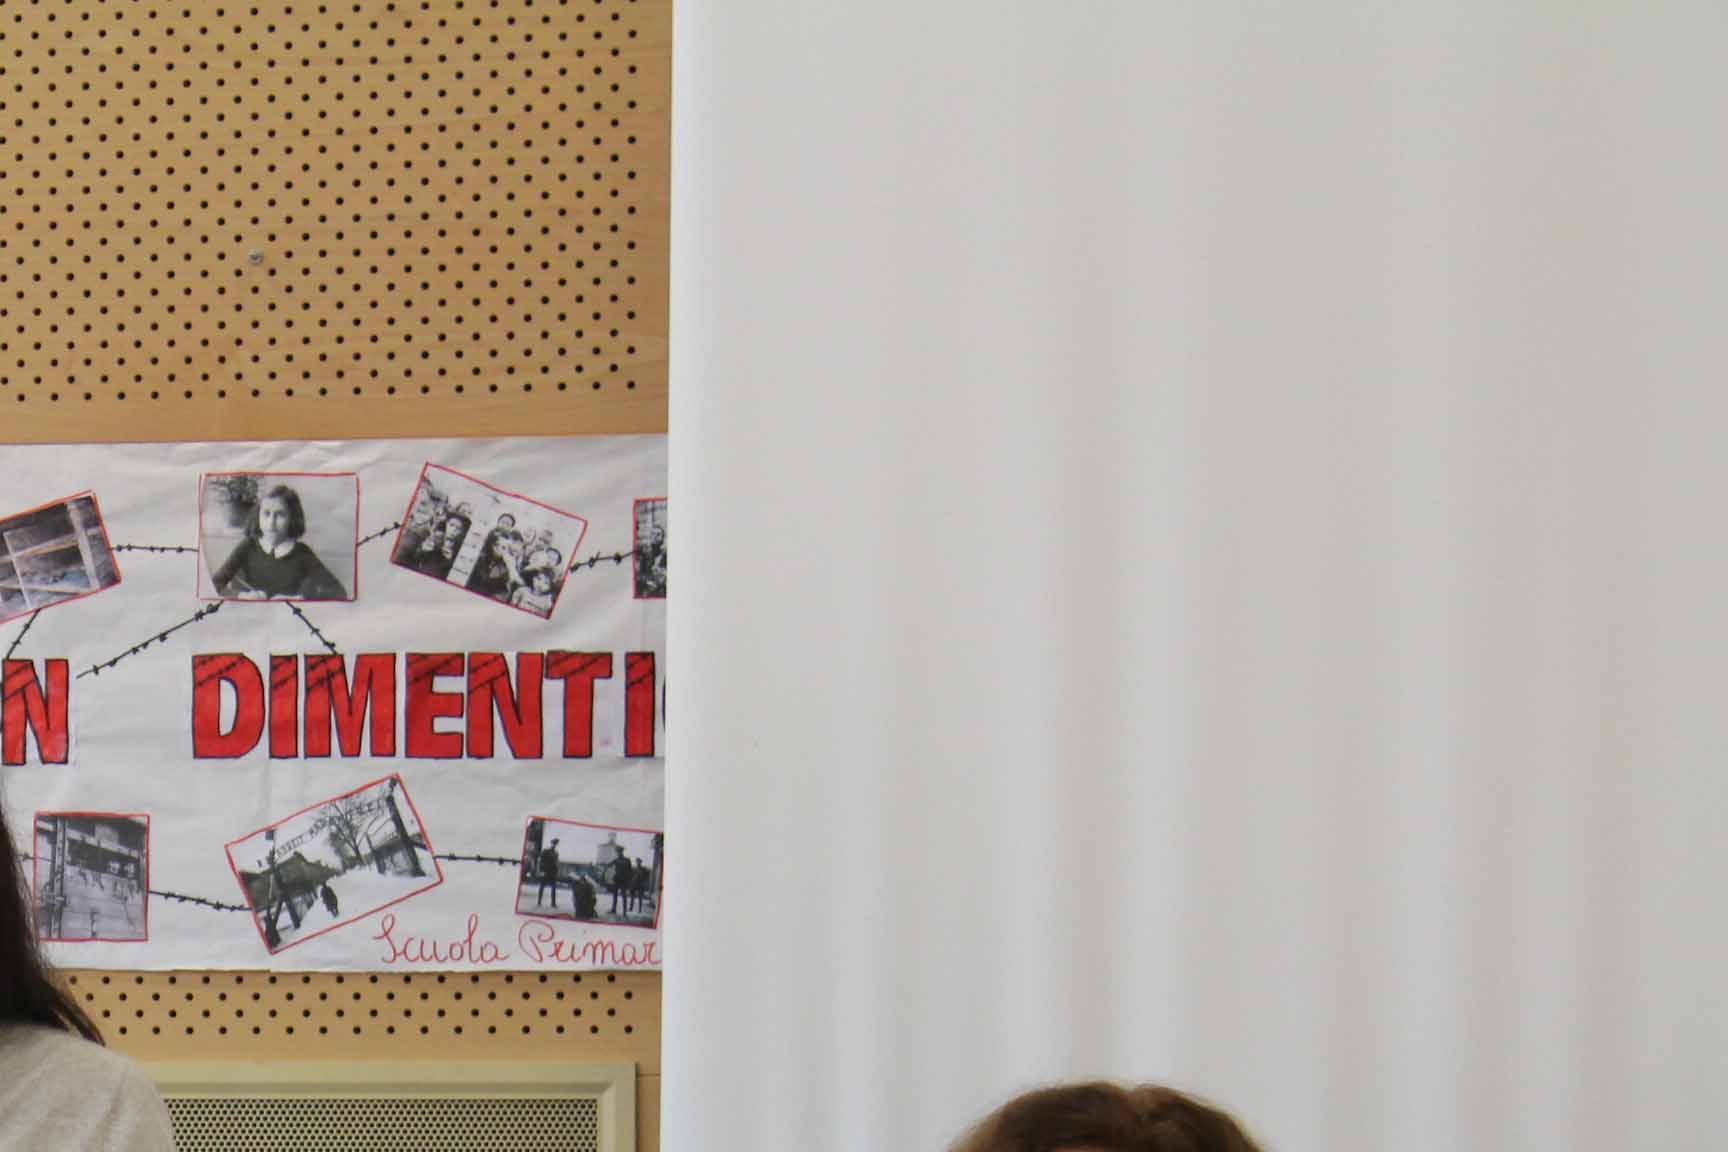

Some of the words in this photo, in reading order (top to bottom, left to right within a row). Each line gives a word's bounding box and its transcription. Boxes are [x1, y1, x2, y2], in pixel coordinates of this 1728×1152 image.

[192, 651, 666, 759] DIMENTI
[372, 913, 511, 964] Scuola
[518, 919, 663, 965] Primar
